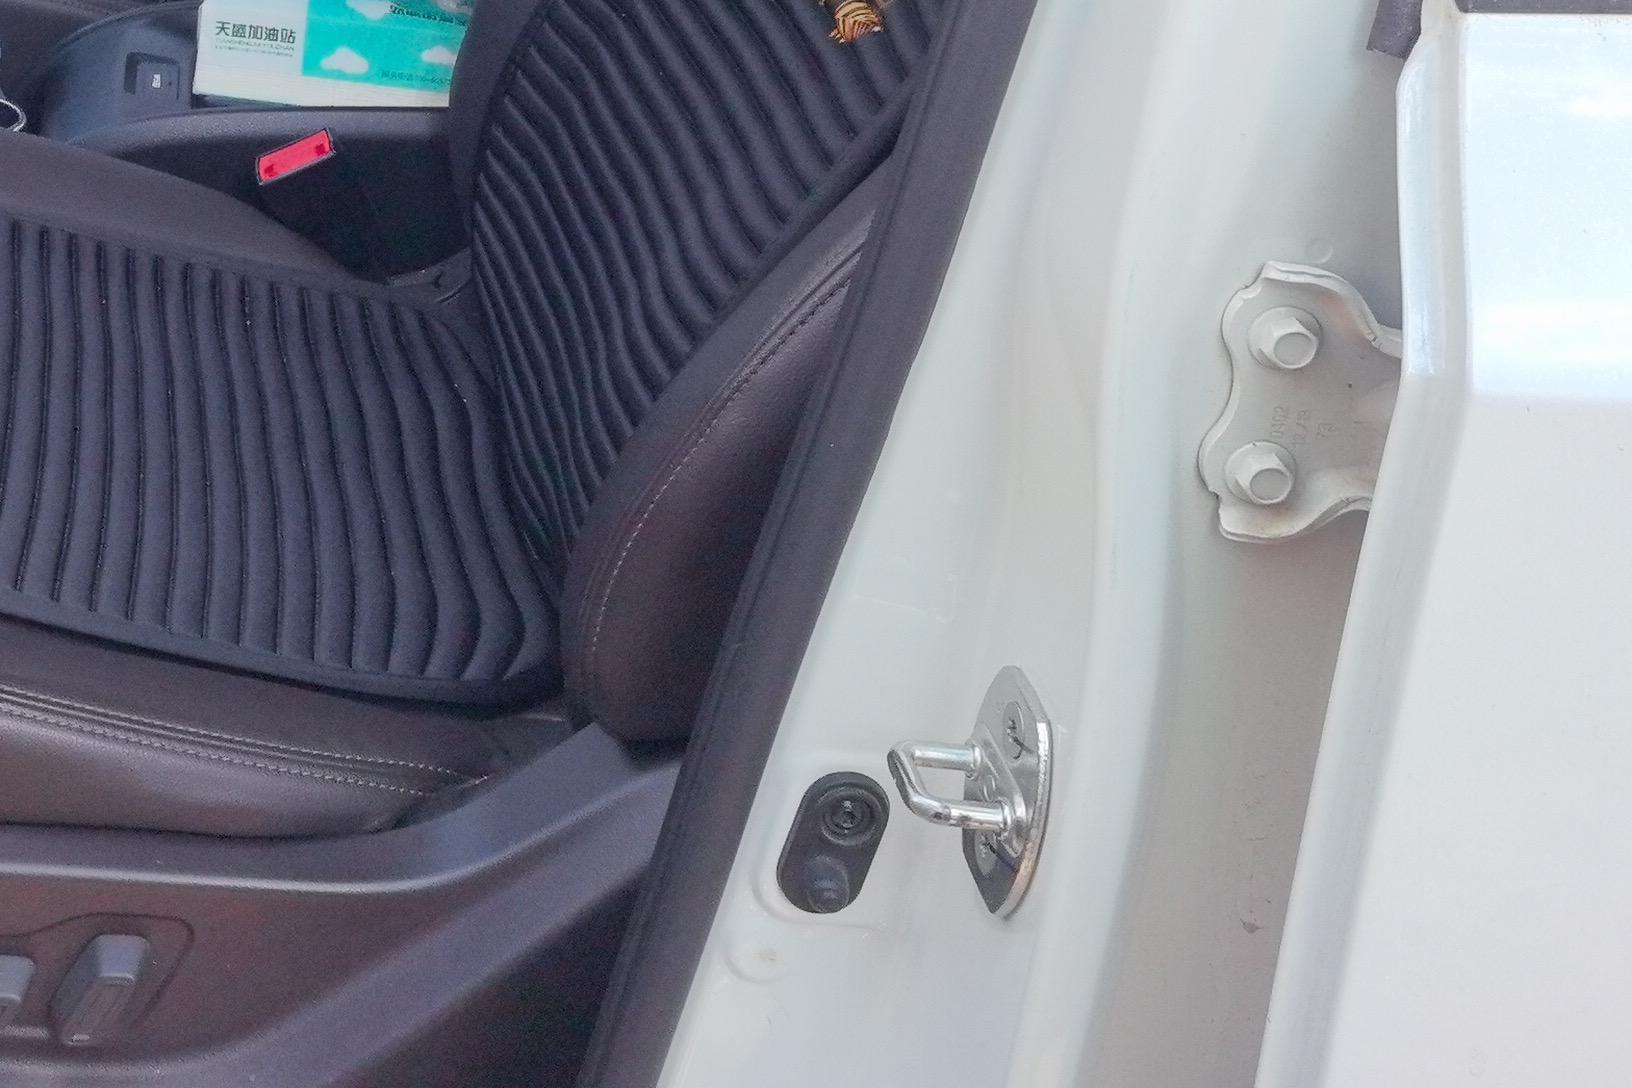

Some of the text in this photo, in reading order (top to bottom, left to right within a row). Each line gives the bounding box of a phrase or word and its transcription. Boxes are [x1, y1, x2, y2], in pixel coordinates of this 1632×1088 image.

[215, 20, 297, 44] 天盛加油站
